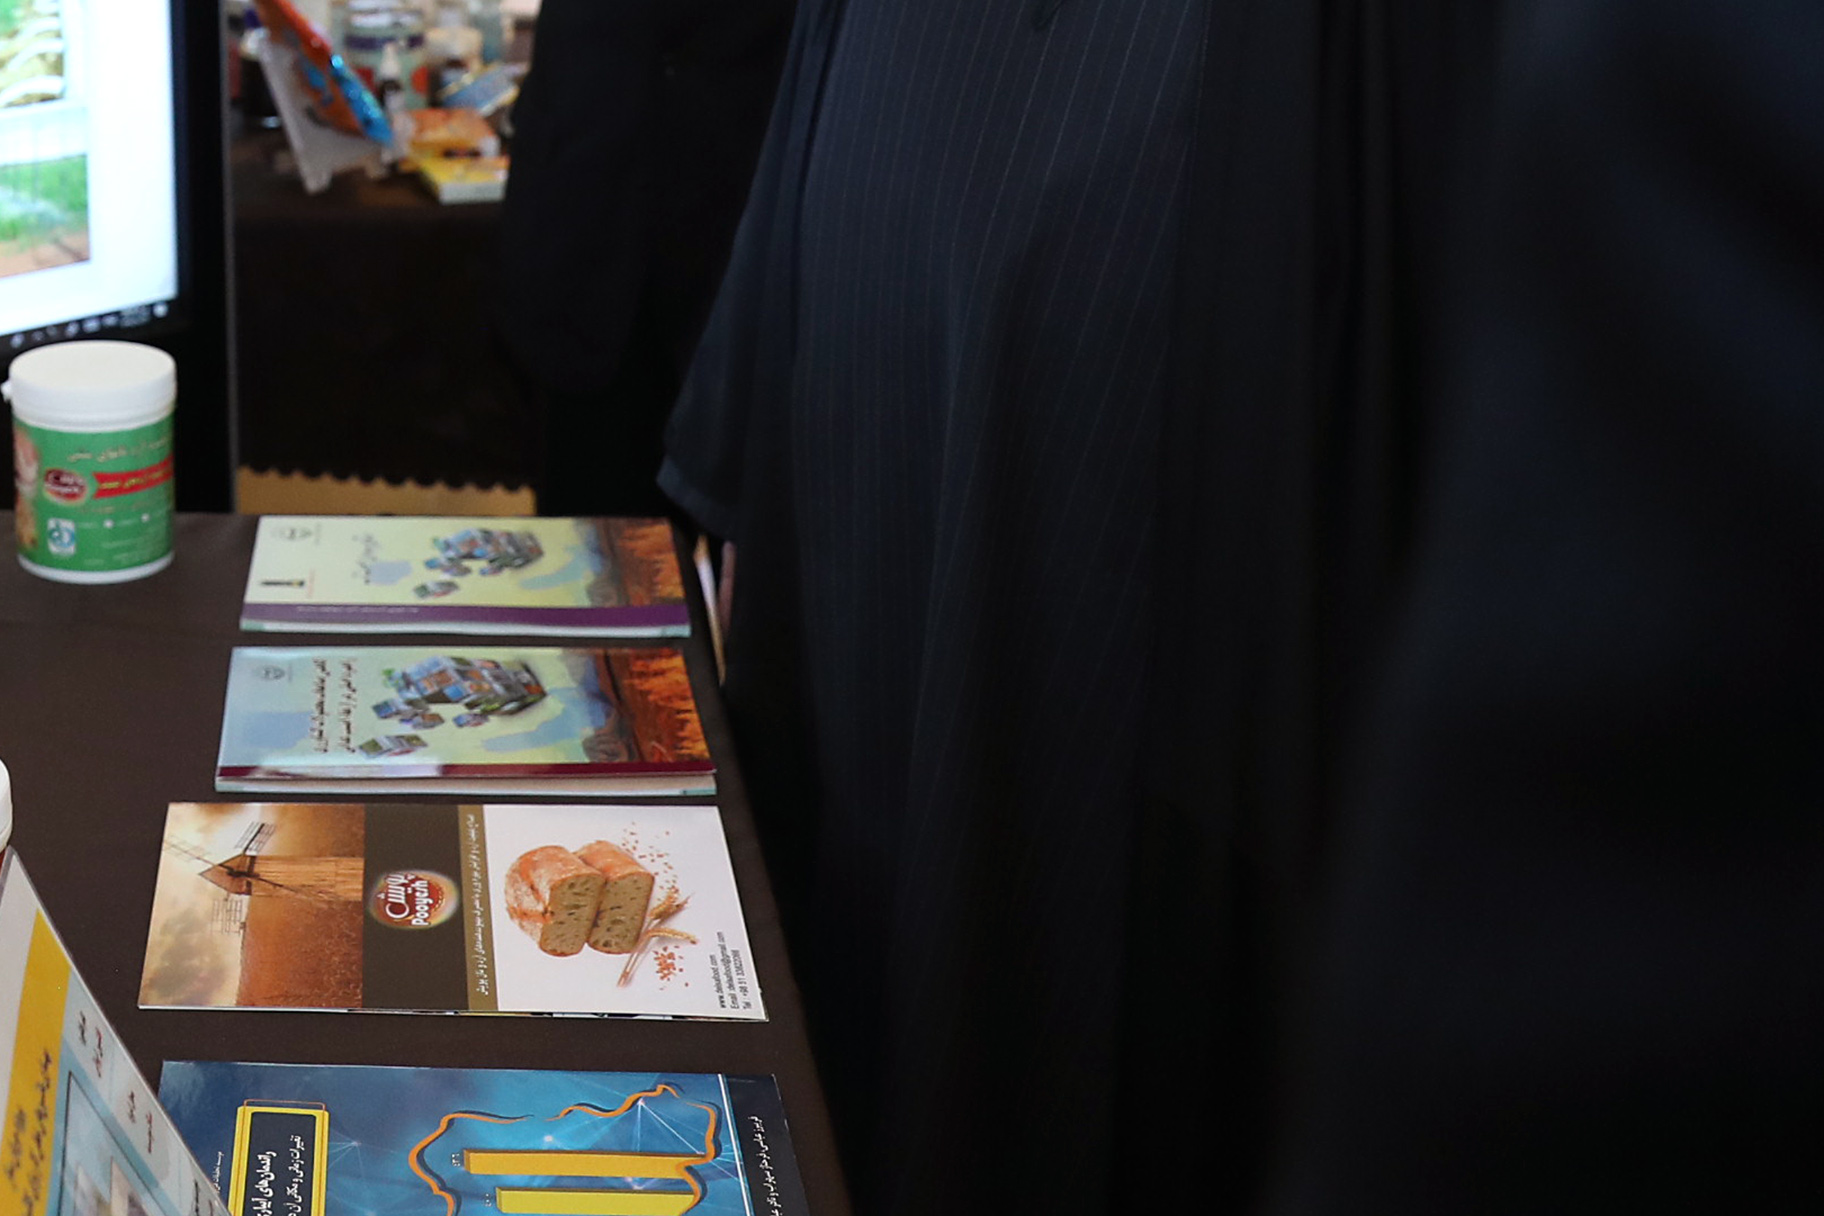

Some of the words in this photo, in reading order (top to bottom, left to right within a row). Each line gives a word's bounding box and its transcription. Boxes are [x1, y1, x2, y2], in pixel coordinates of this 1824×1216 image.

[377, 873, 416, 919] پویش
[411, 879, 434, 926] Pooyesh
[289, 1134, 306, 1160] تغییرات
[288, 1159, 305, 1178] زمانی
[285, 1182, 303, 1203] مکانی
